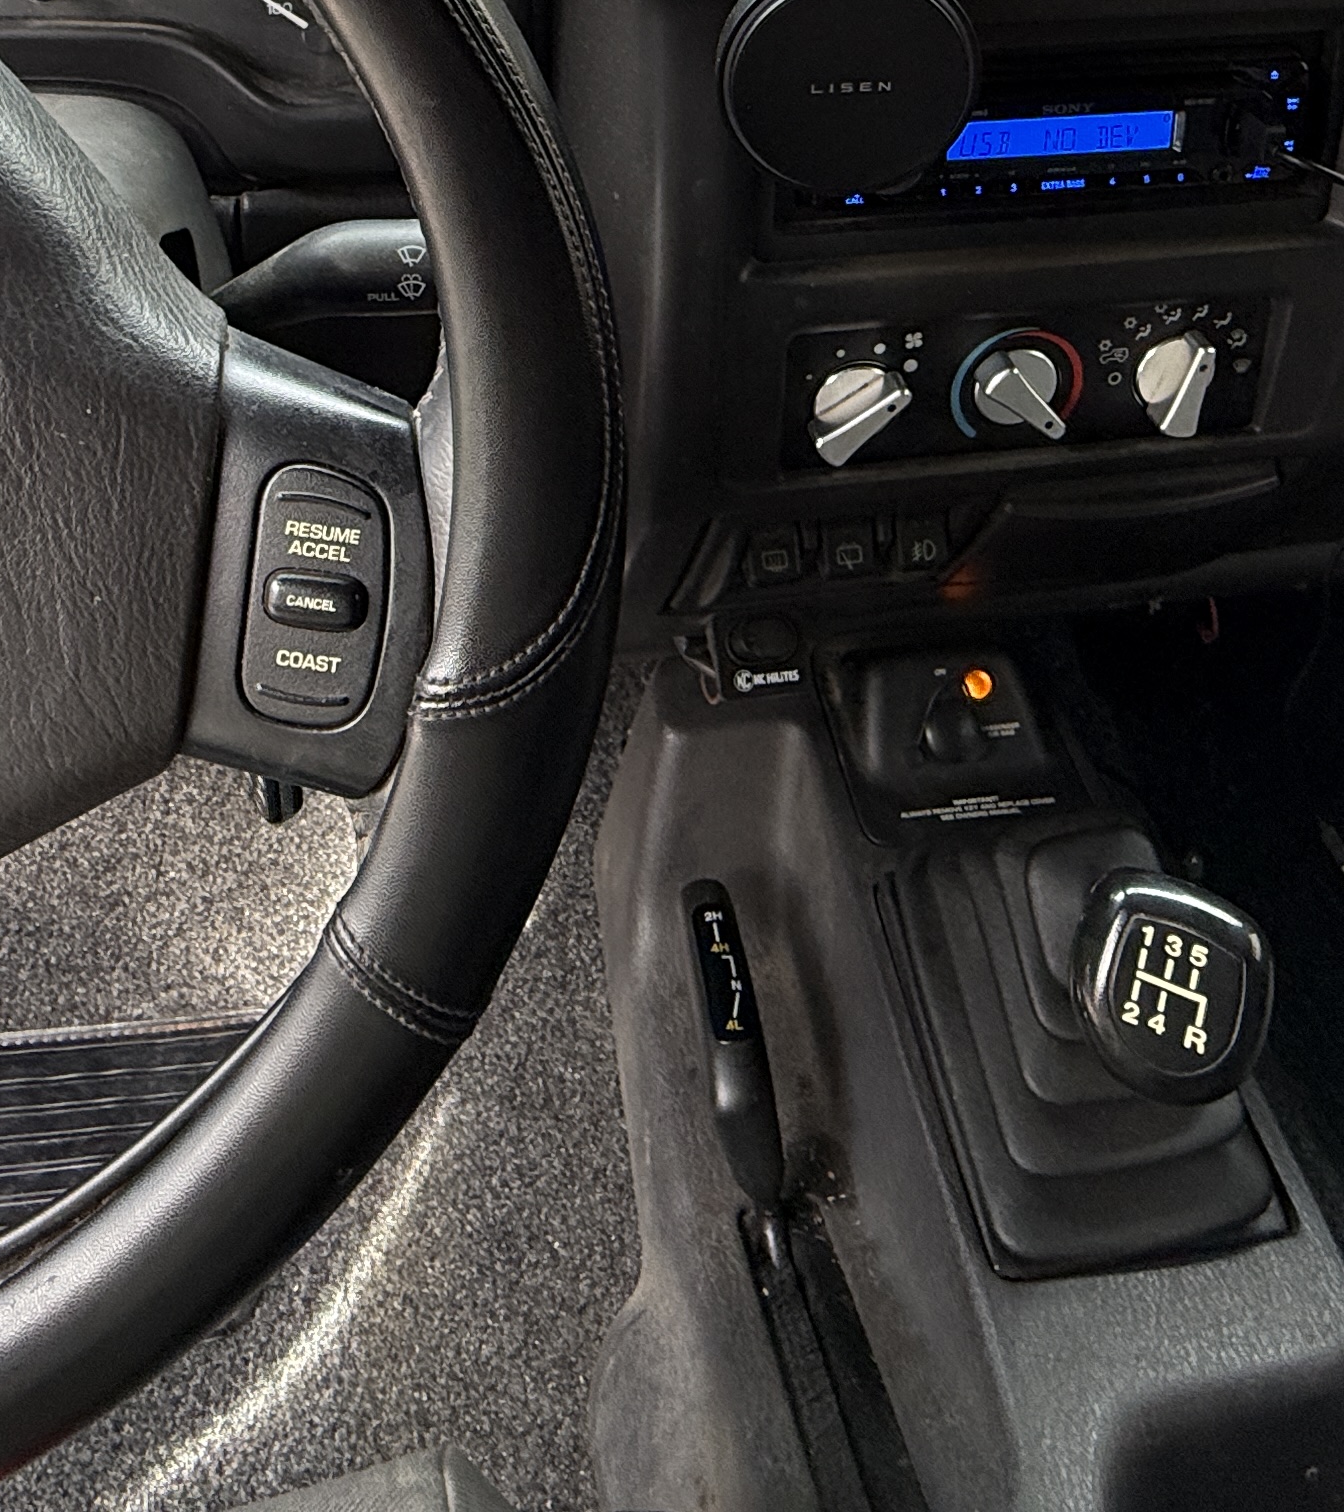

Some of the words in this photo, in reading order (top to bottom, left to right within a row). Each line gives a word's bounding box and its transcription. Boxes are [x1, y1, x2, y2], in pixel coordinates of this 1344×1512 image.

[811, 81, 891, 94] LISEN
[1042, 102, 1095, 116] SONY
[959, 131, 1010, 157] USB
[1043, 127, 1076, 151] NO
[1097, 124, 1140, 150] DEV
[1010, 183, 1018, 192] 3
[367, 292, 400, 302] PULL
[285, 520, 361, 545] RESUME
[288, 540, 351, 562] ACCEL
[286, 594, 336, 612] CANCEL
[276, 649, 342, 675] COAST
[704, 911, 723, 922] 2H
[1142, 926, 1154, 947] 1
[1164, 934, 1183, 958] 3
[710, 942, 730, 953] 4H
[1189, 944, 1209, 968] 5
[731, 979, 742, 991] N
[1121, 1001, 1140, 1026] 2
[725, 1019, 744, 1031] 4L
[1147, 1013, 1166, 1036] 4
[1184, 1025, 1207, 1055] R
